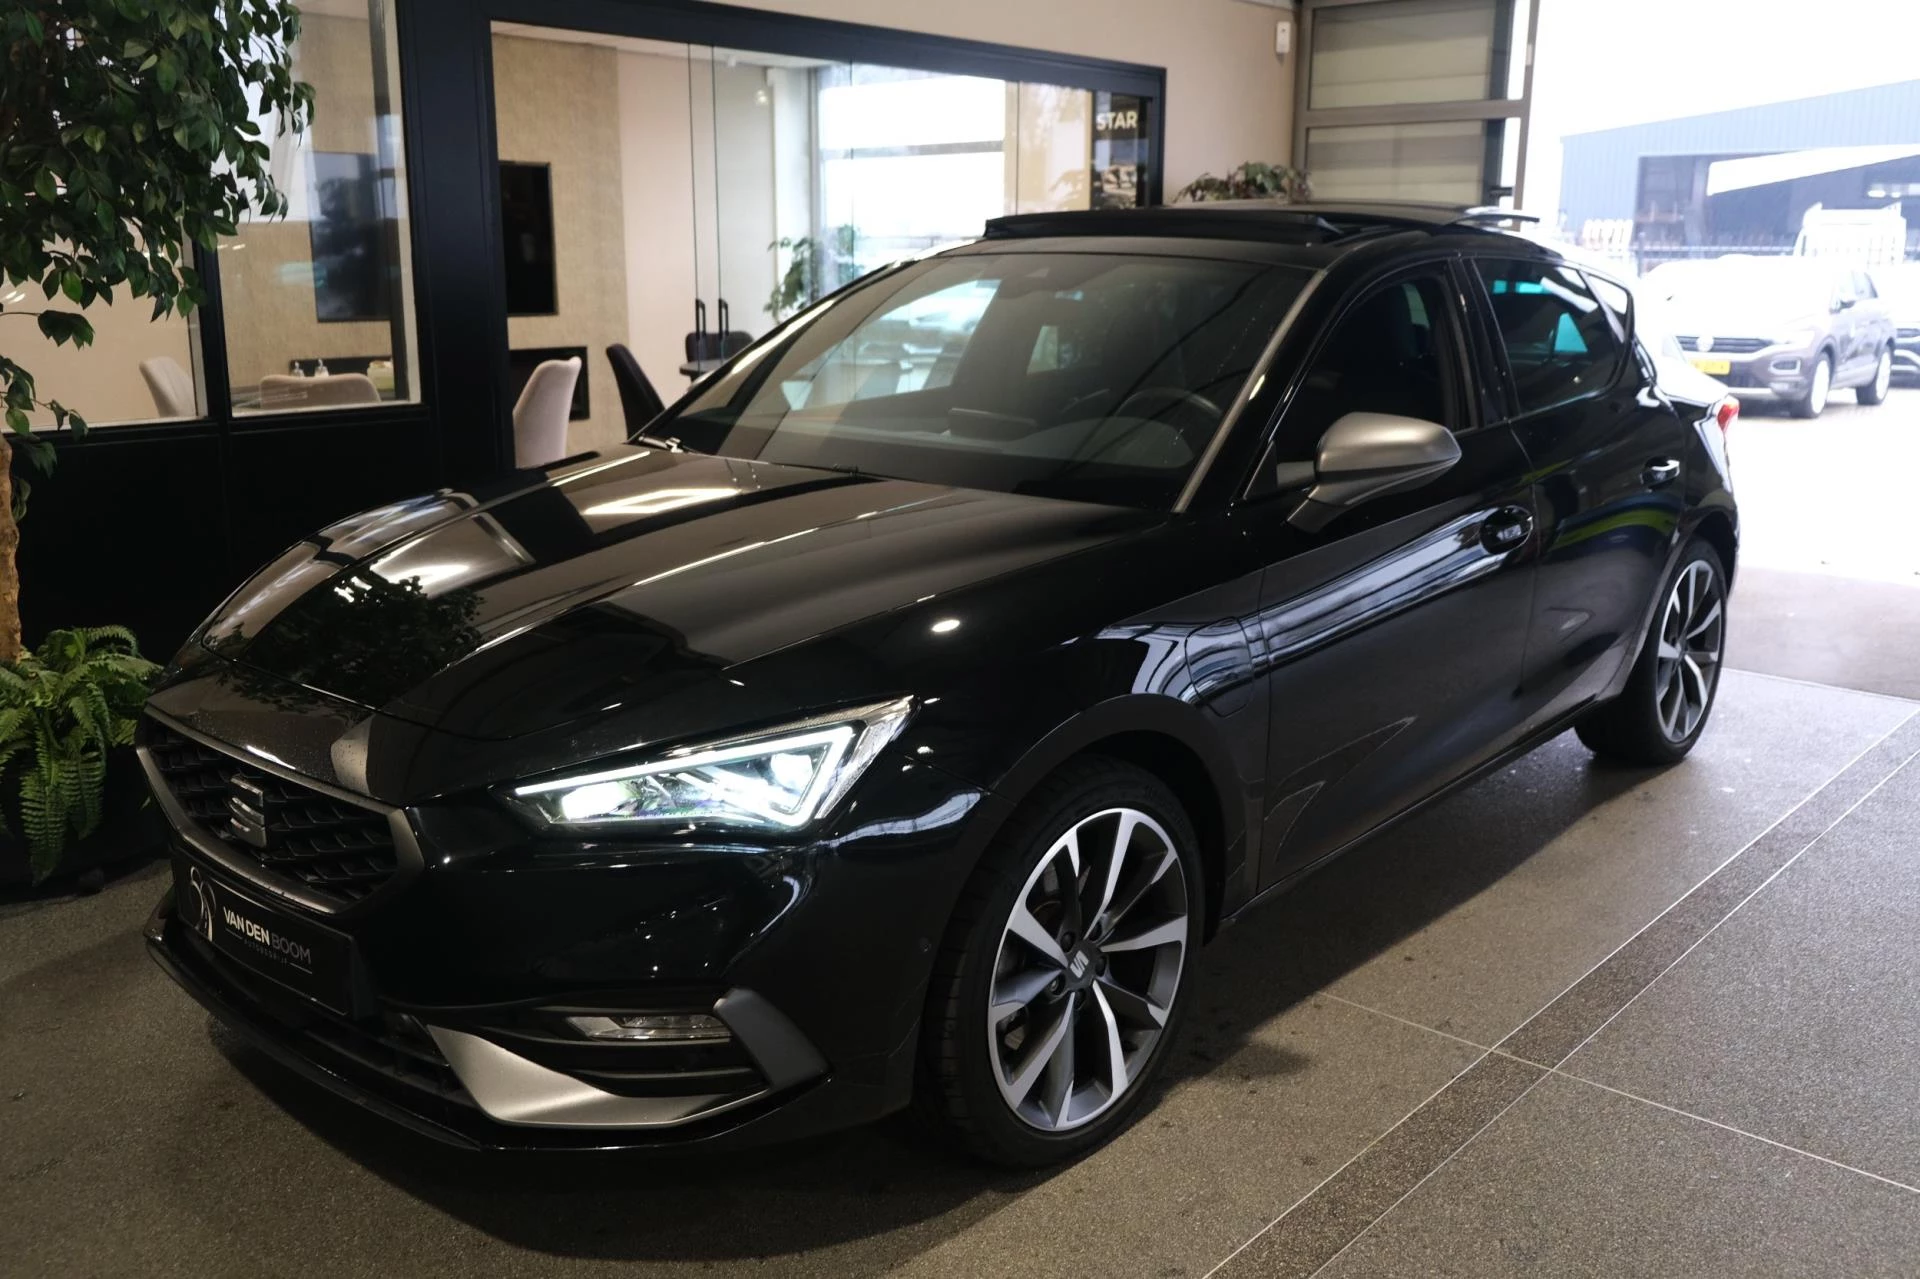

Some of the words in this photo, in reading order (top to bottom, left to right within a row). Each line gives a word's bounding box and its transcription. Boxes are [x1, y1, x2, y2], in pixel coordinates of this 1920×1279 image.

[1096, 111, 1138, 130] STAR
[223, 906, 245, 933] VAN
[245, 921, 270, 946] DEN
[271, 932, 312, 965] BOOM
